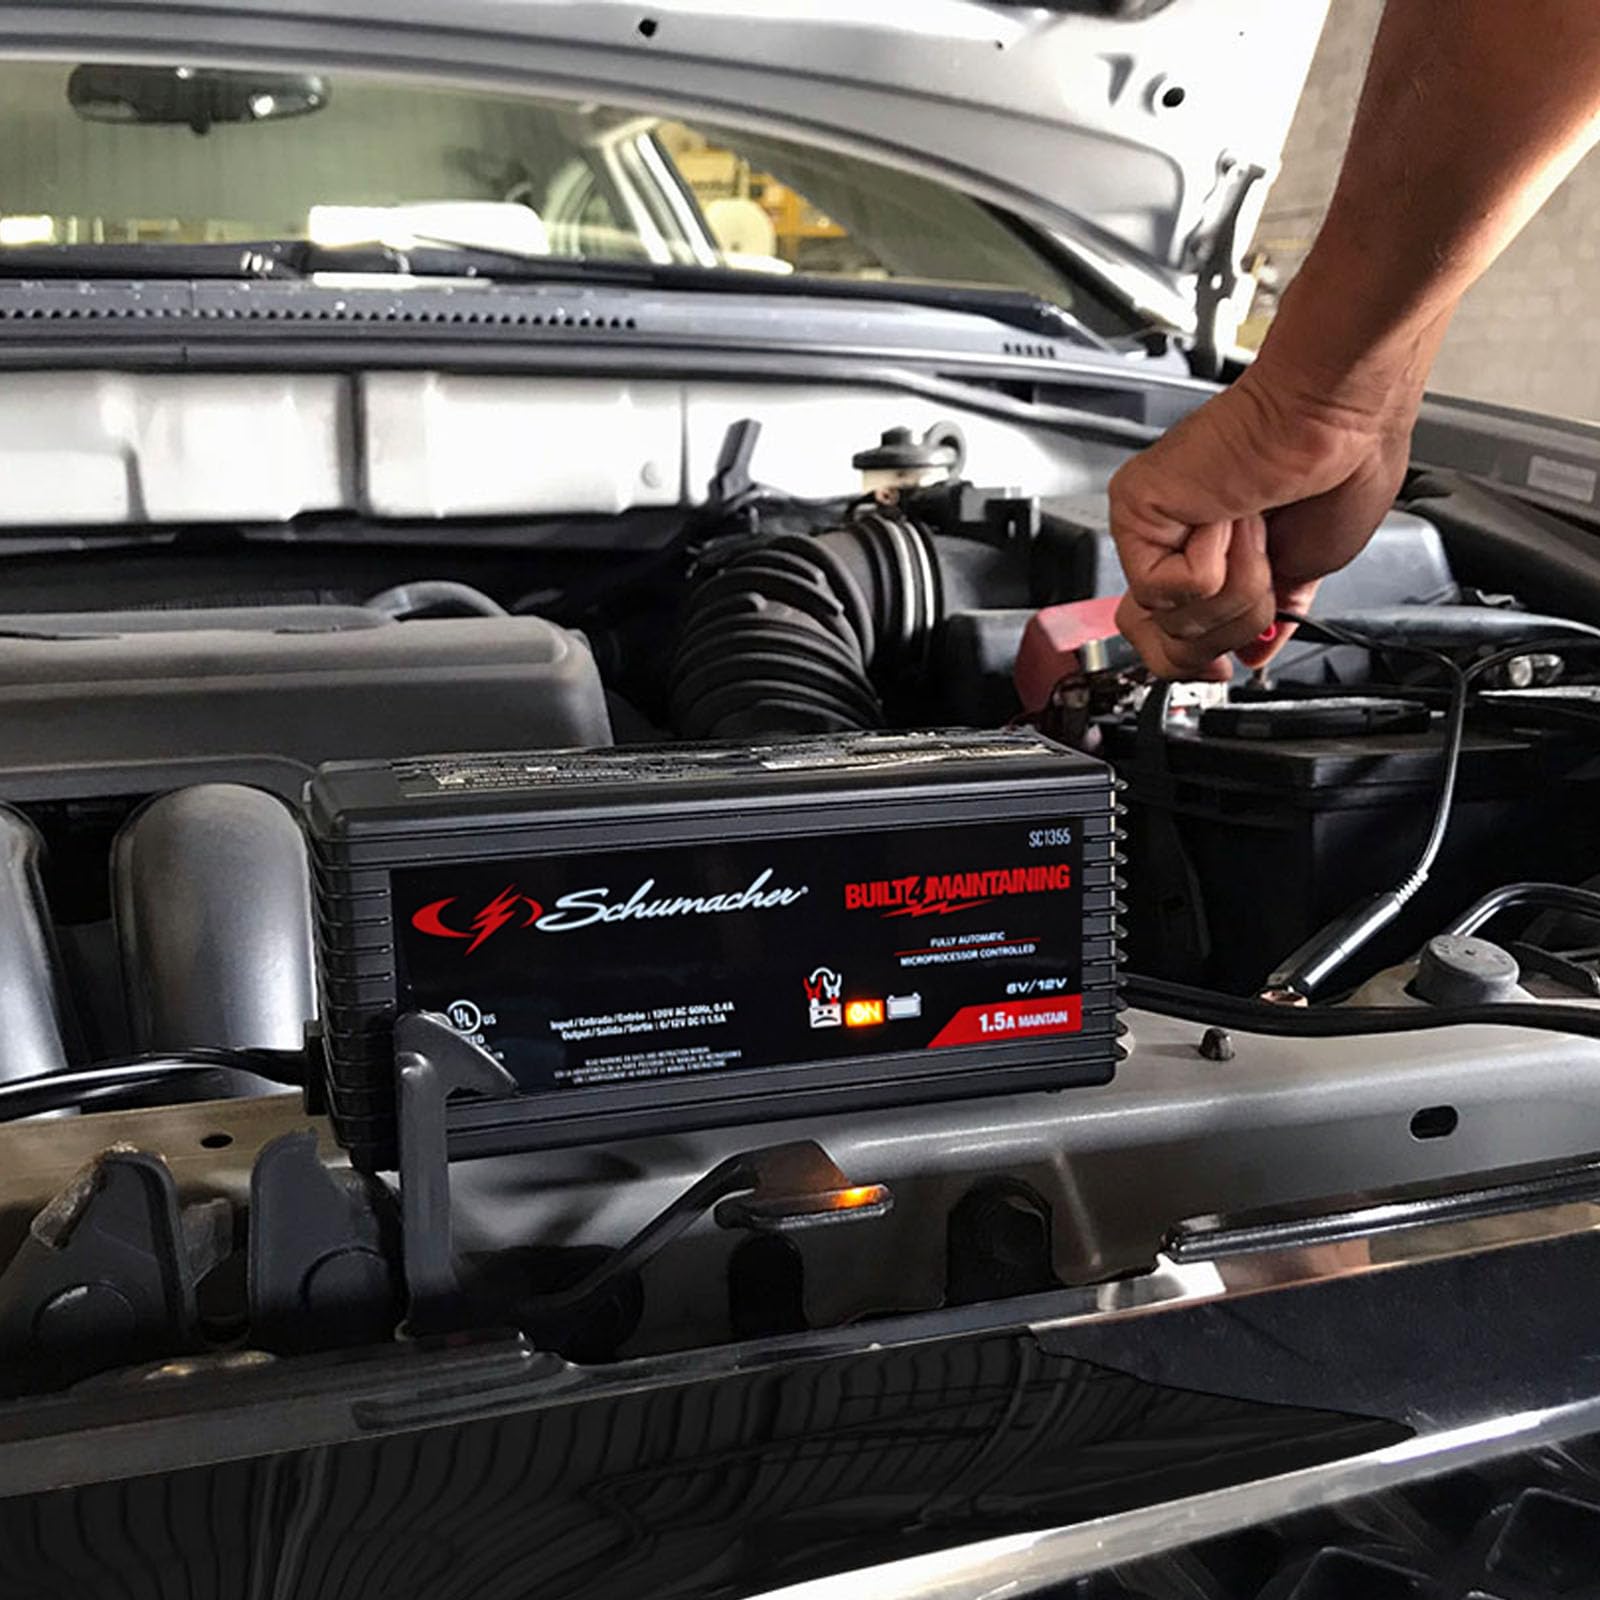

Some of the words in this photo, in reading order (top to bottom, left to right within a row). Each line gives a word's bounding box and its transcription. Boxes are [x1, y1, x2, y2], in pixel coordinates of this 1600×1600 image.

[535, 868, 802, 932] Schumacher
[930, 937, 957, 947] FULLY
[958, 931, 1005, 944] AUTOMATIC
[900, 949, 978, 966] MICROPROCESSOR
[979, 943, 1036, 959] CONTROLLED
[850, 1001, 880, 1023] ON
[1018, 1010, 1068, 1028] MAINTAIN
